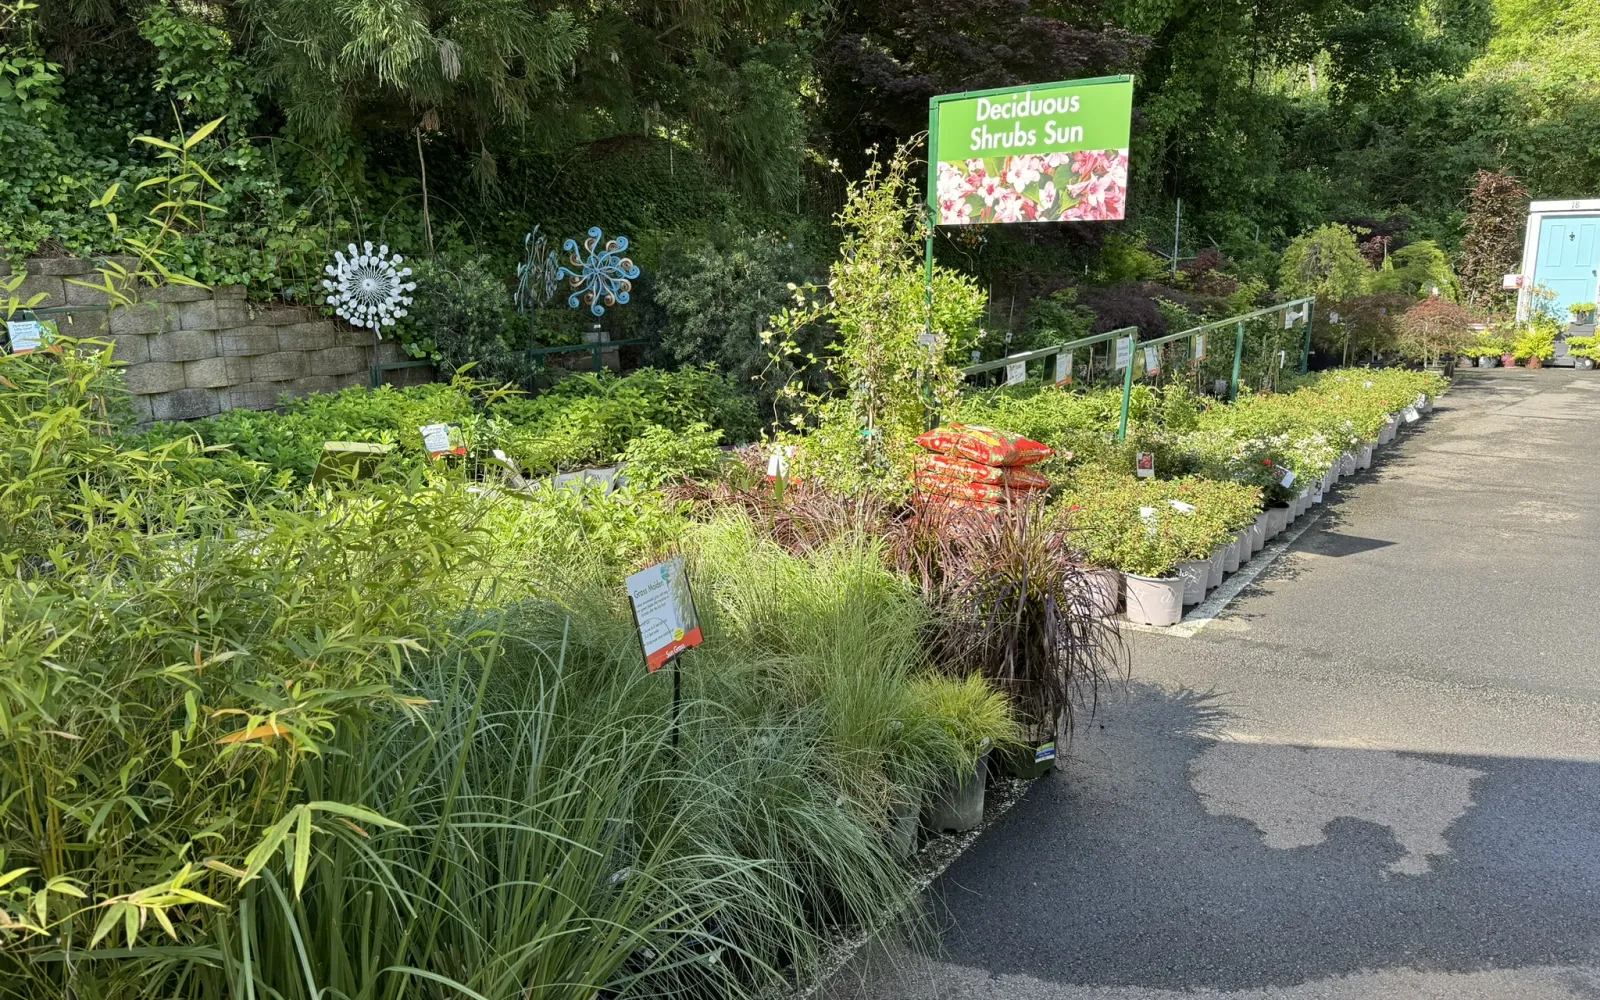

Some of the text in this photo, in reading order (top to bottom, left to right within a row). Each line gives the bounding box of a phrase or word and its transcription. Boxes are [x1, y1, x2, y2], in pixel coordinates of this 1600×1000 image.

[976, 91, 1080, 121] Deciduous
[970, 120, 1083, 151] Shrubs Sun
[1571, 201, 1580, 209] 18
[634, 580, 665, 599] Grass Maiden
